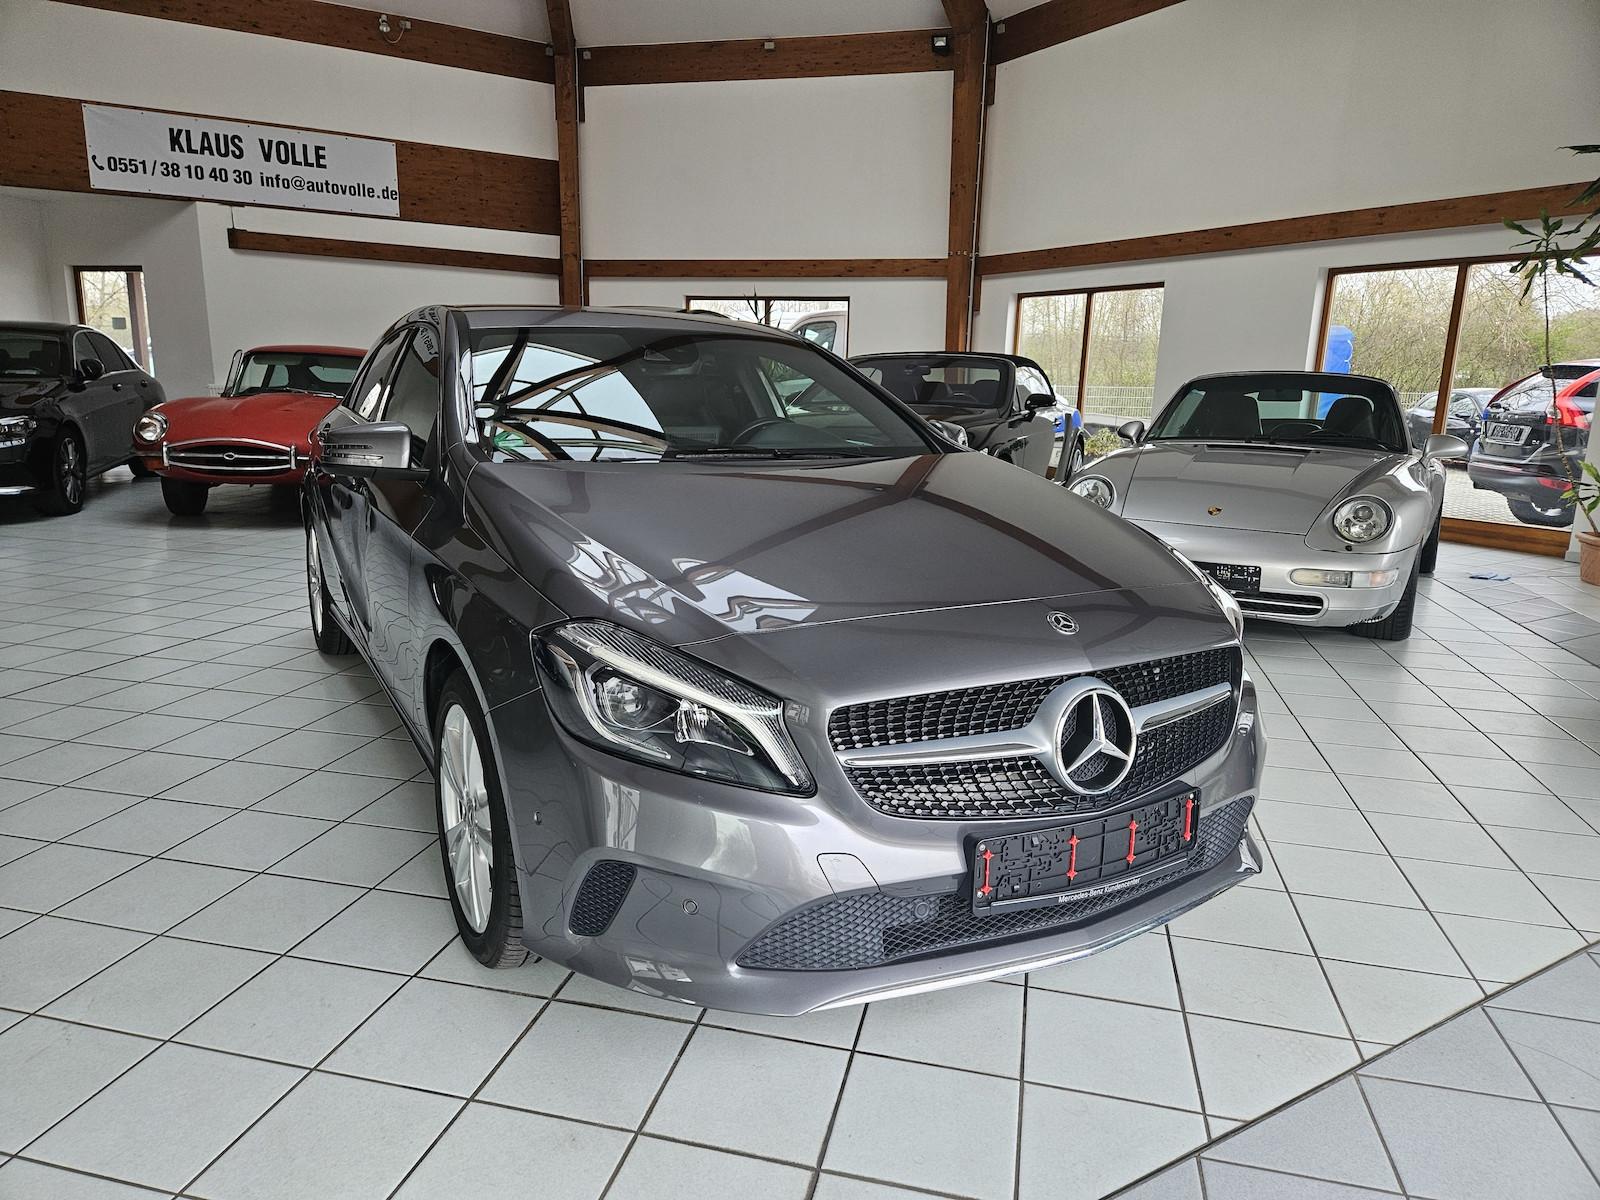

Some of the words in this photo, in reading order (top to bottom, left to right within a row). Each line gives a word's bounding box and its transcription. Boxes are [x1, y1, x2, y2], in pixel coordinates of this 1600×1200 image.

[168, 127, 245, 159] KLAUS
[258, 138, 327, 169] VOLLE
[184, 164, 204, 181] 10
[209, 167, 229, 183] 40
[233, 169, 253, 185] 30
[260, 172, 398, 200] info@autovolle.de
[1058, 888, 1104, 903] Mercedes-Benz
[1104, 878, 1140, 893] Kundencenter
